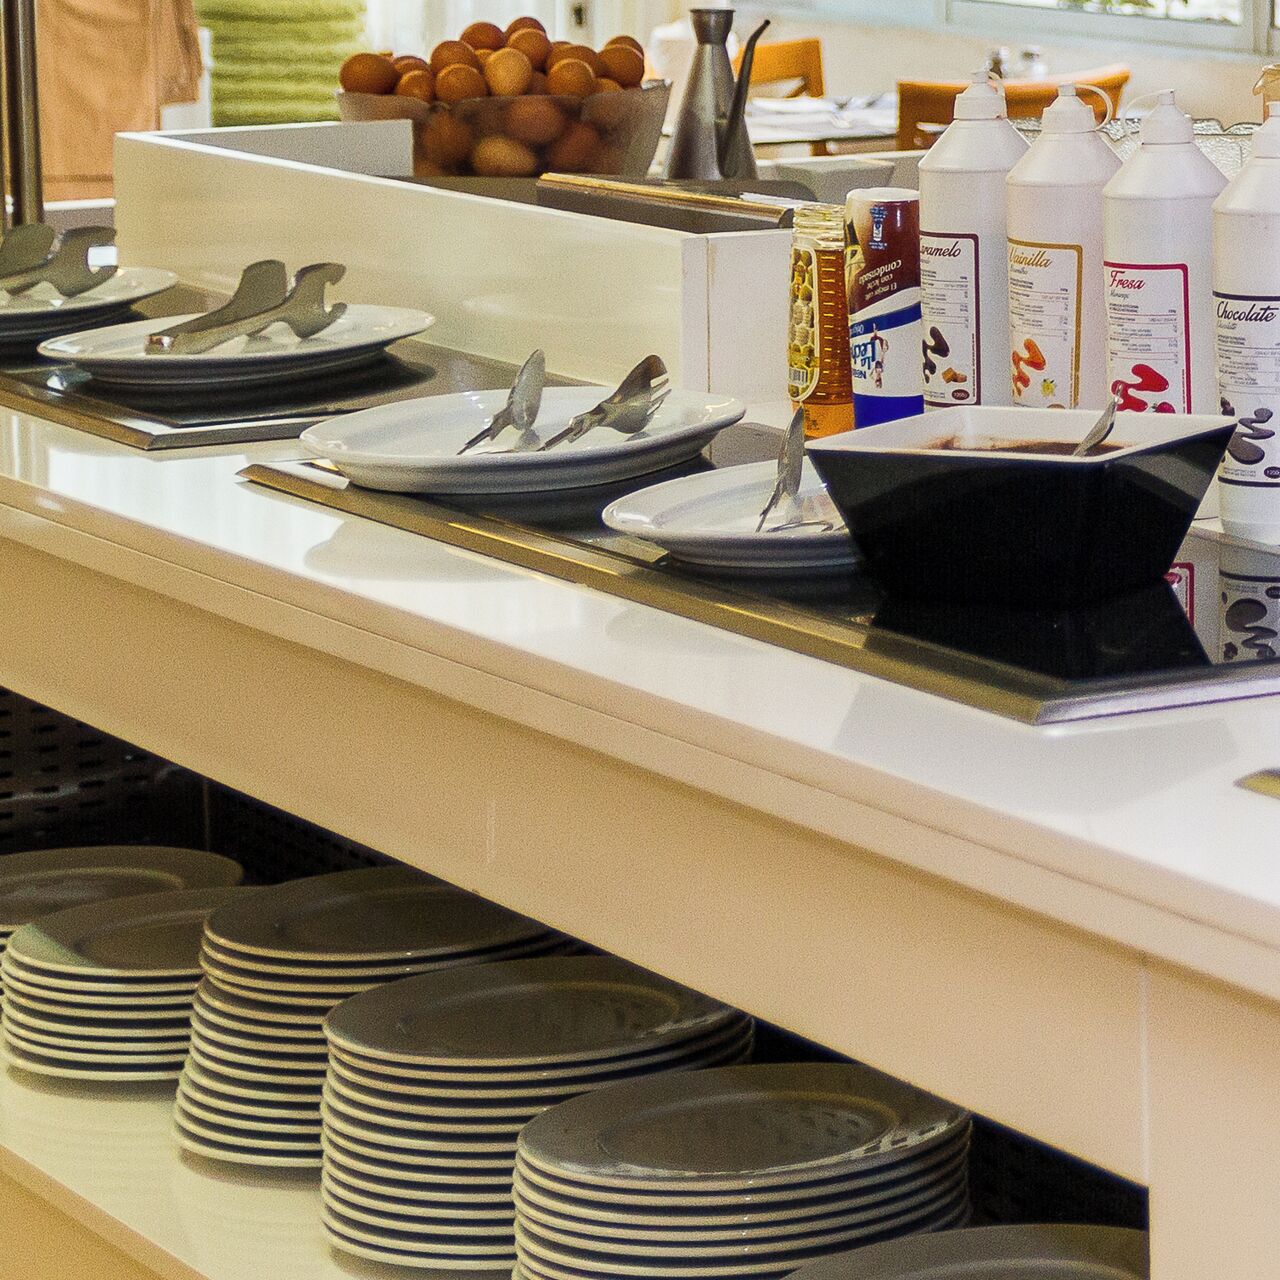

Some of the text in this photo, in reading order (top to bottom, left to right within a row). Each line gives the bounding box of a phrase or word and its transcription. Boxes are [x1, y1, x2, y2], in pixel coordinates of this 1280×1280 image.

[1009, 247, 1053, 268] Vainilla
[1109, 270, 1146, 290] Fresa
[1216, 300, 1280, 322] Chocolate
